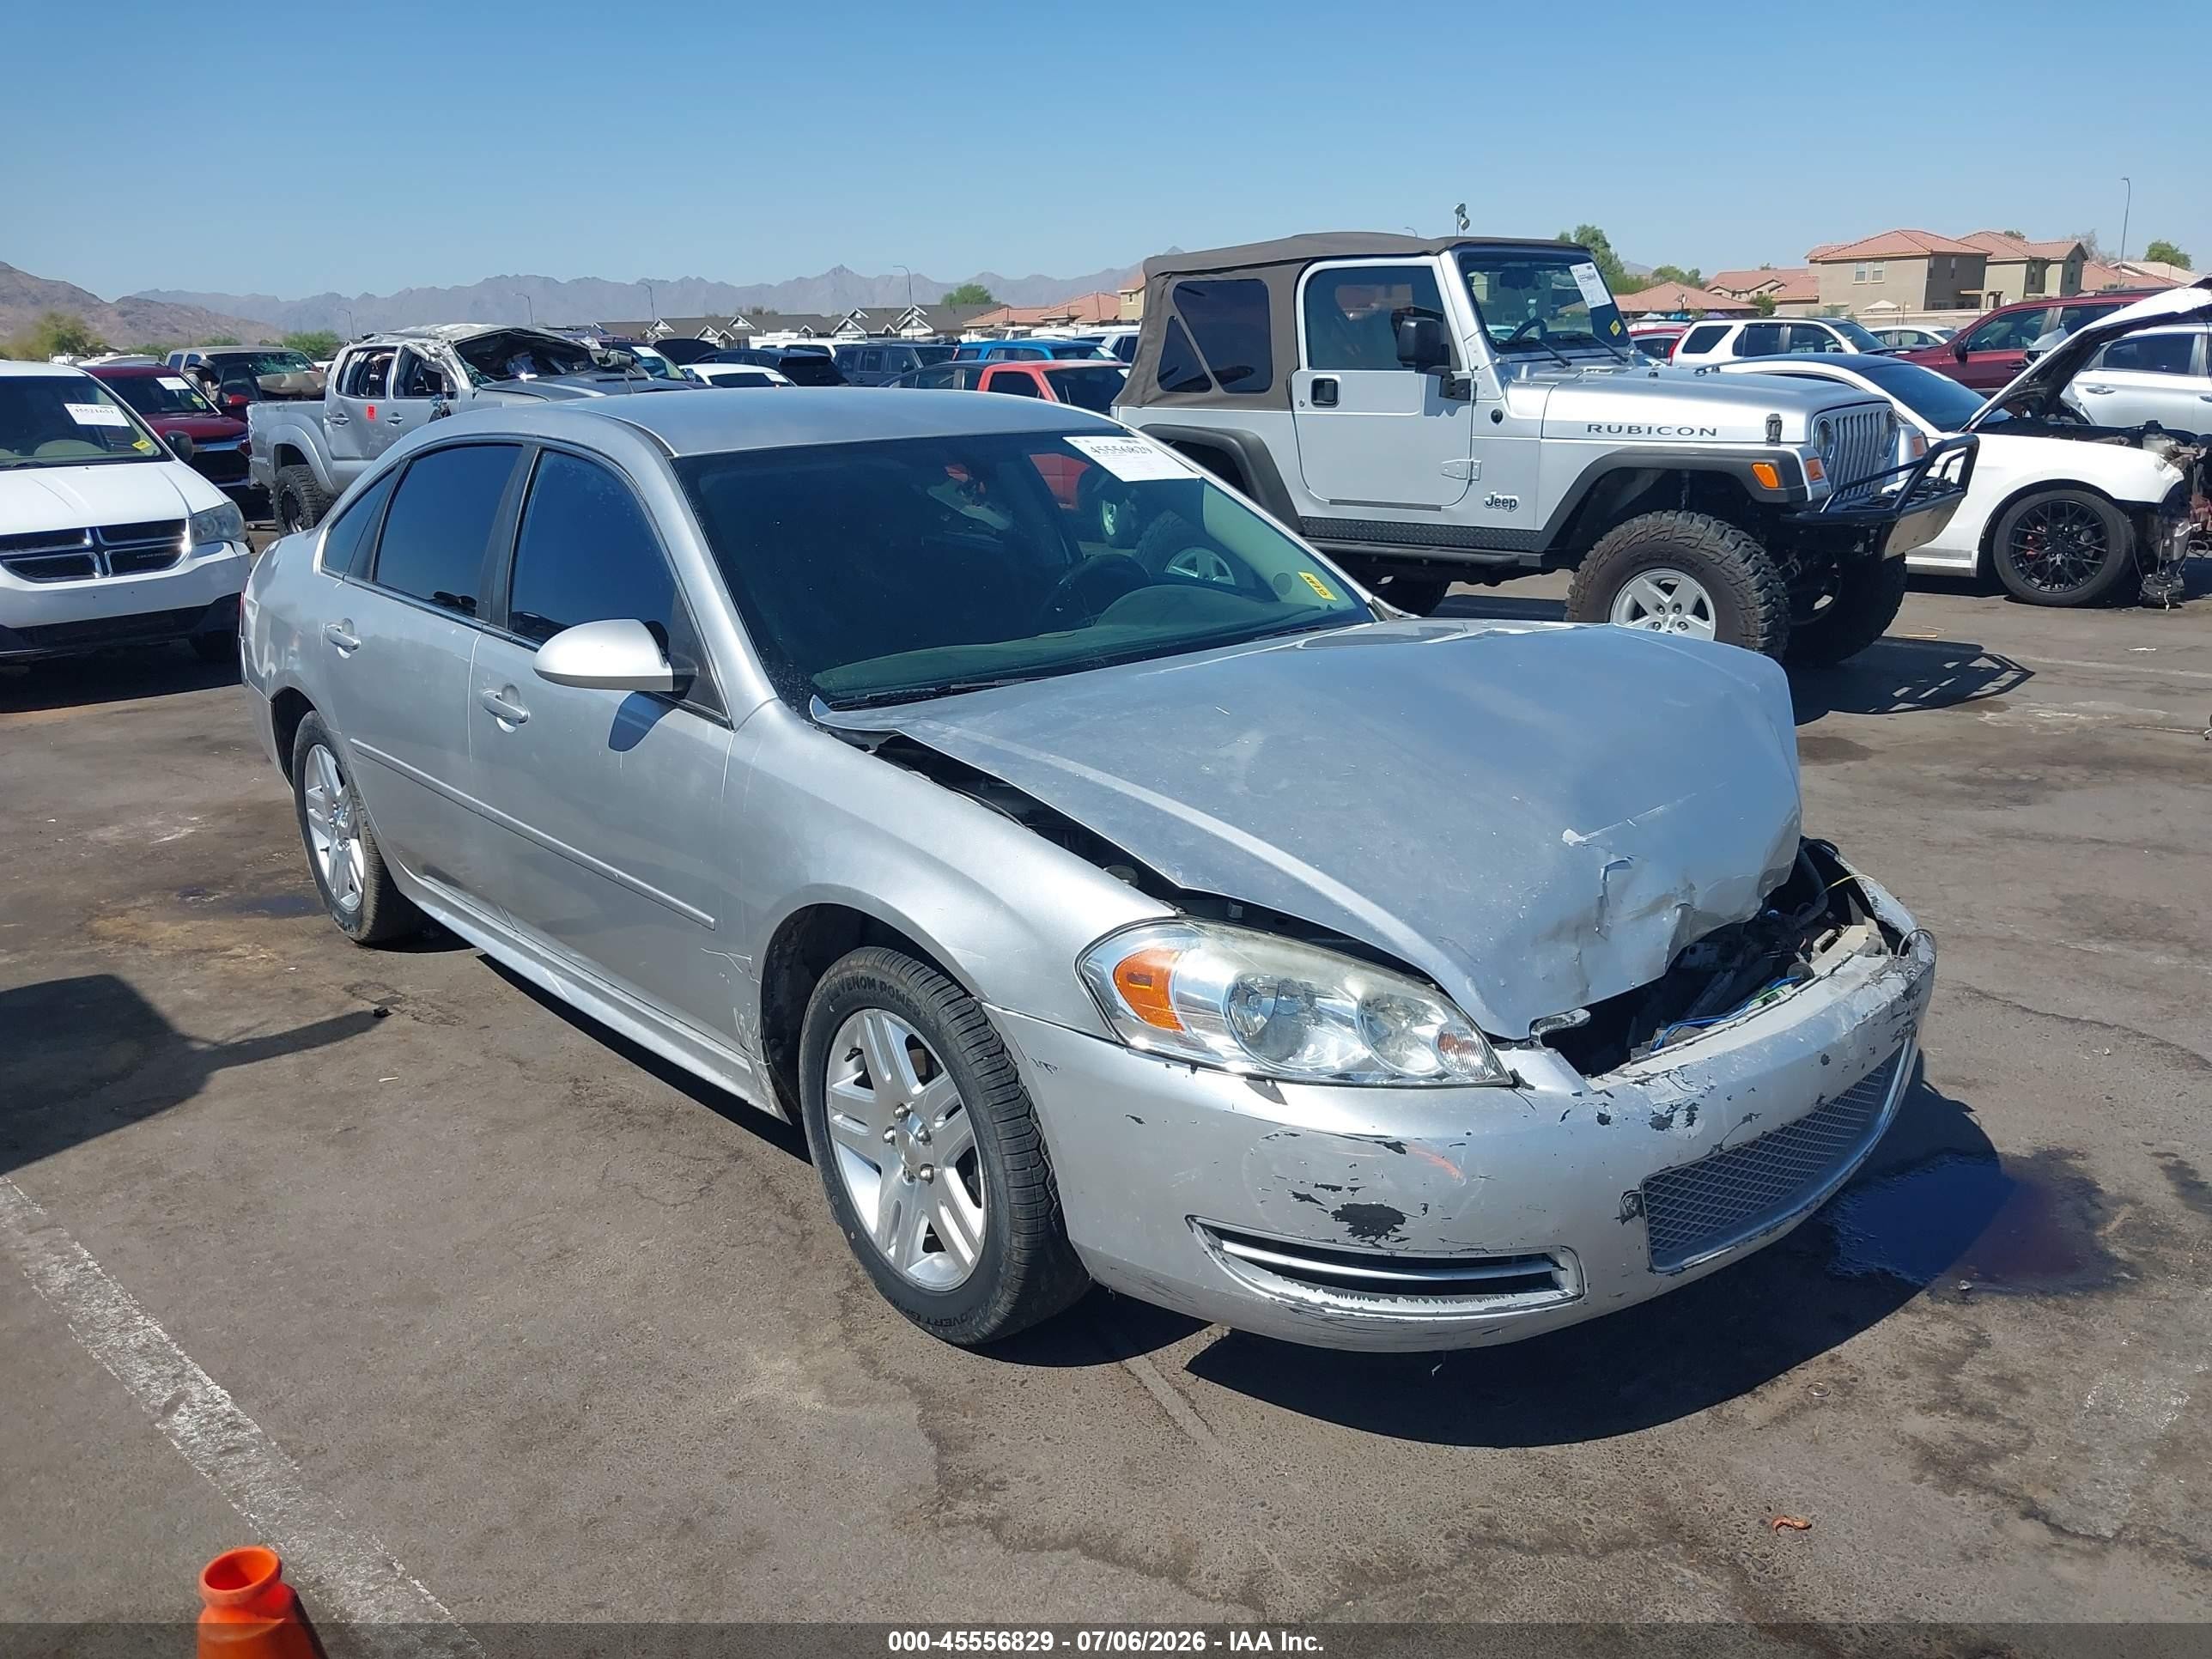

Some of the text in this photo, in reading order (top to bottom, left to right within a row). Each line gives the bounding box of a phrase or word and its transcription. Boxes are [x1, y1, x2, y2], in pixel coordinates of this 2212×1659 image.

[1587, 424, 1717, 436] RUBICON
[1090, 446, 1153, 454] 45556829
[1485, 491, 1518, 512] Jeep
[840, 975, 876, 993] VENOM
